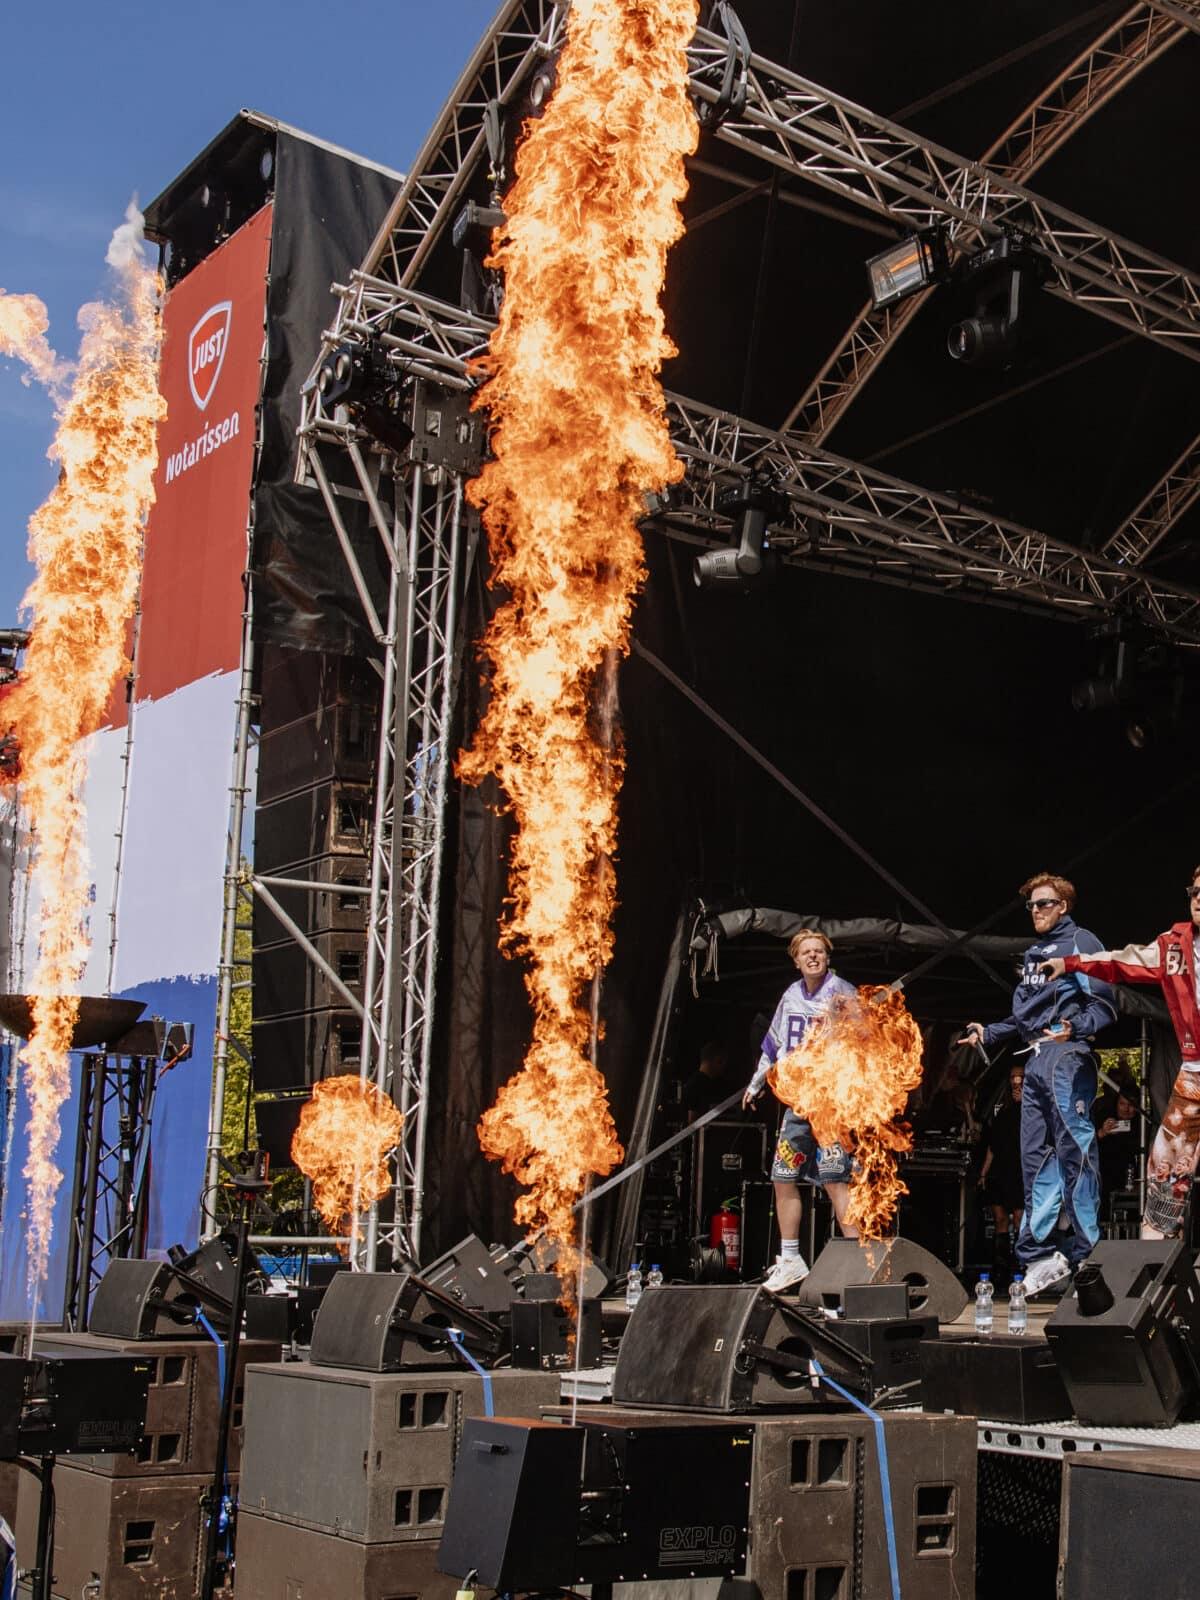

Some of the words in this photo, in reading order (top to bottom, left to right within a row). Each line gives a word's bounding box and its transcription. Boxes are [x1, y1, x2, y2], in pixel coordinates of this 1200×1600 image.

[194, 327, 225, 375] JUST
[165, 411, 240, 485] Notarissen
[659, 1525, 737, 1550] EXPLO
